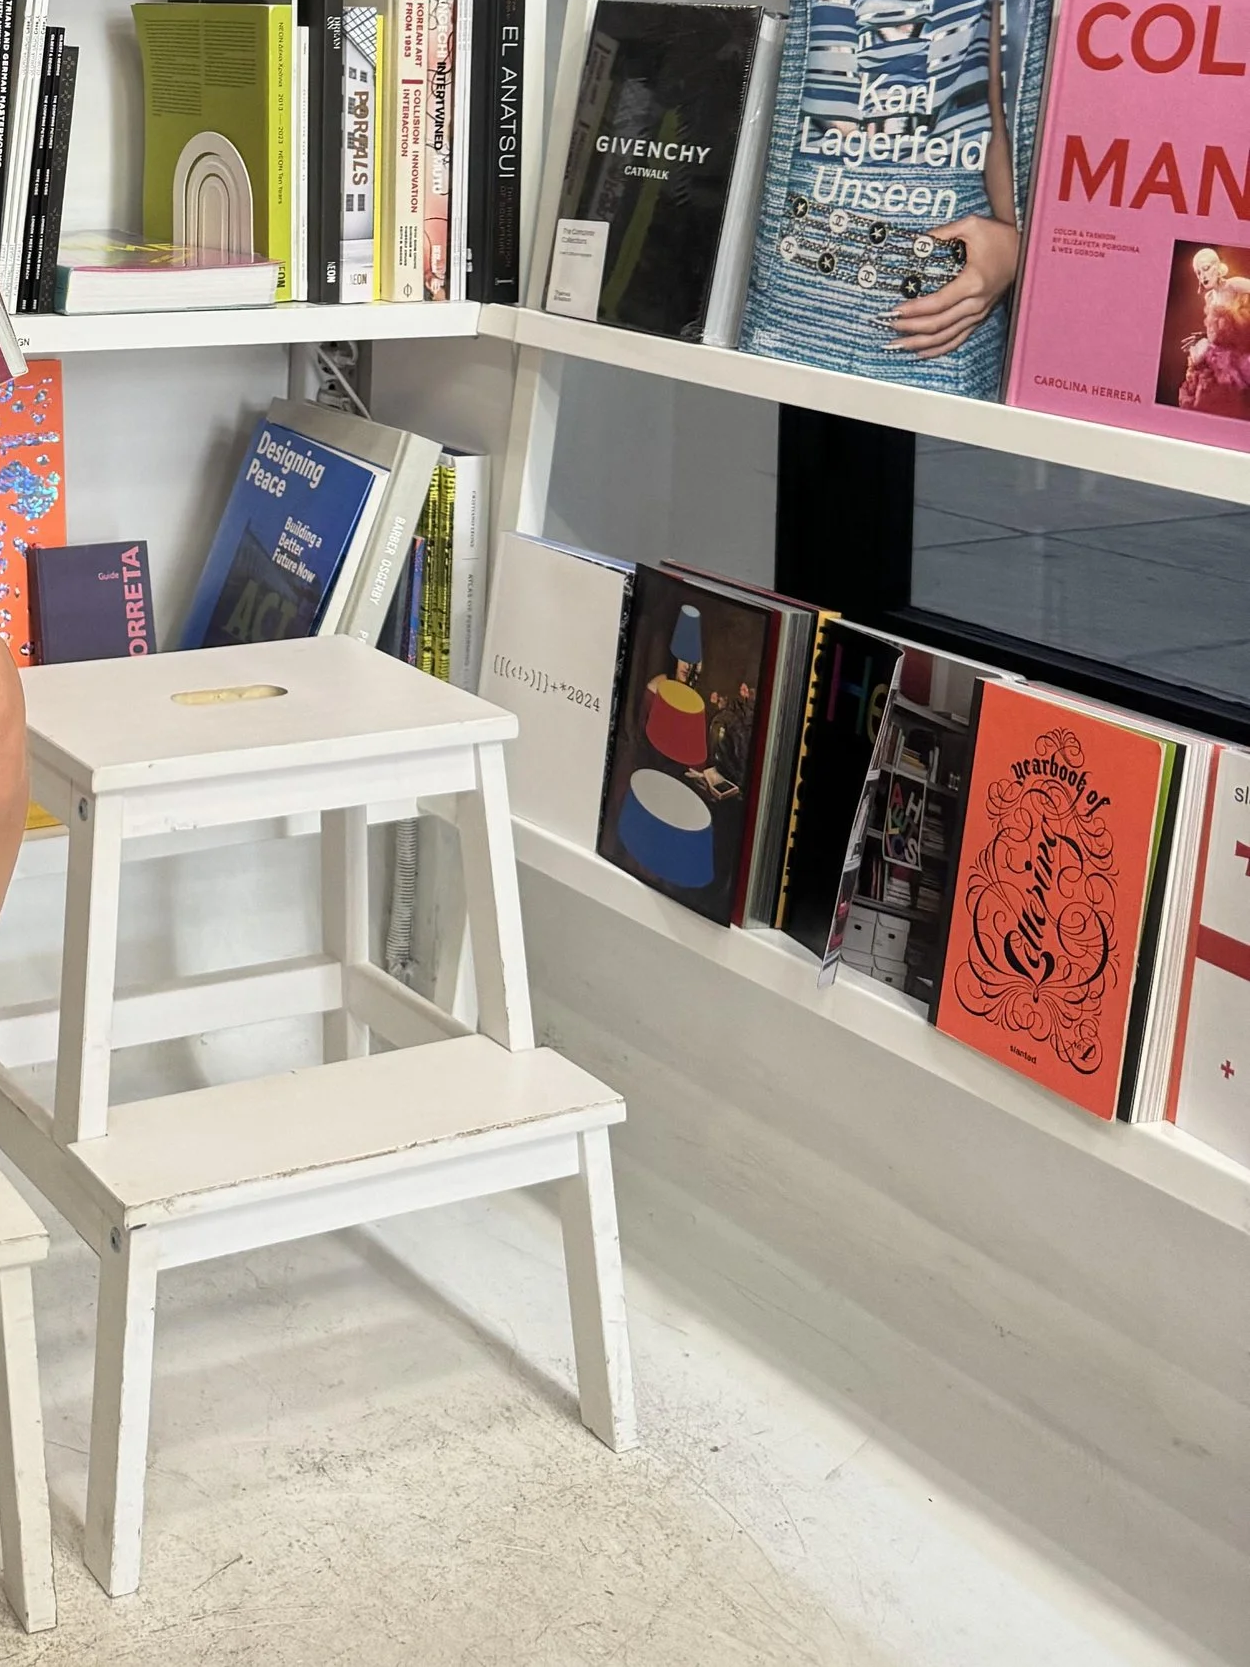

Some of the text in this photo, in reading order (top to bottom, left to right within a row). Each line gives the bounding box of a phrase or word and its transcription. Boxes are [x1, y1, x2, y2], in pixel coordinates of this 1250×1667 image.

[332, 16, 342, 50] DREAM
[403, 2, 413, 33] FROM
[413, 2, 425, 68] KOREAN ART
[2, 31, 12, 50] AND
[502, 25, 518, 57] EL
[1075, 0, 1247, 78] COL
[0, 53, 10, 93] GERMAN
[434, 61, 447, 151] INTERTWINED
[856, 76, 936, 117] Karl
[277, 94, 286, 171] 2013 2023 NEON
[352, 90, 370, 186] PORTALS
[400, 88, 410, 158] INTERACTION
[498, 66, 518, 179] ANATSUI
[410, 88, 422, 214] COLLISION INNOVATION
[595, 134, 713, 164] GIVENCHY
[799, 115, 990, 172] Lagerfeld
[623, 165, 670, 181] CATWALK
[811, 164, 958, 220] Unseen
[1057, 134, 1250, 222] MAN
[1053, 227, 1116, 242] COLOR FASHION
[1058, 247, 1106, 259] WES GORDON
[1063, 237, 1100, 249] ELIZAVETA
[1034, 374, 1142, 404] CAROLINA HERRERA
[245, 457, 287, 499] Peace
[256, 430, 325, 490] Designing
[278, 531, 305, 557] Better
[283, 515, 317, 547] Building
[97, 570, 120, 582] Guide
[272, 547, 317, 585] Future Now
[369, 515, 407, 606] BARBER OSGERBY
[1010, 753, 1111, 818] yearbook of
[1009, 1044, 1037, 1066] slanted
